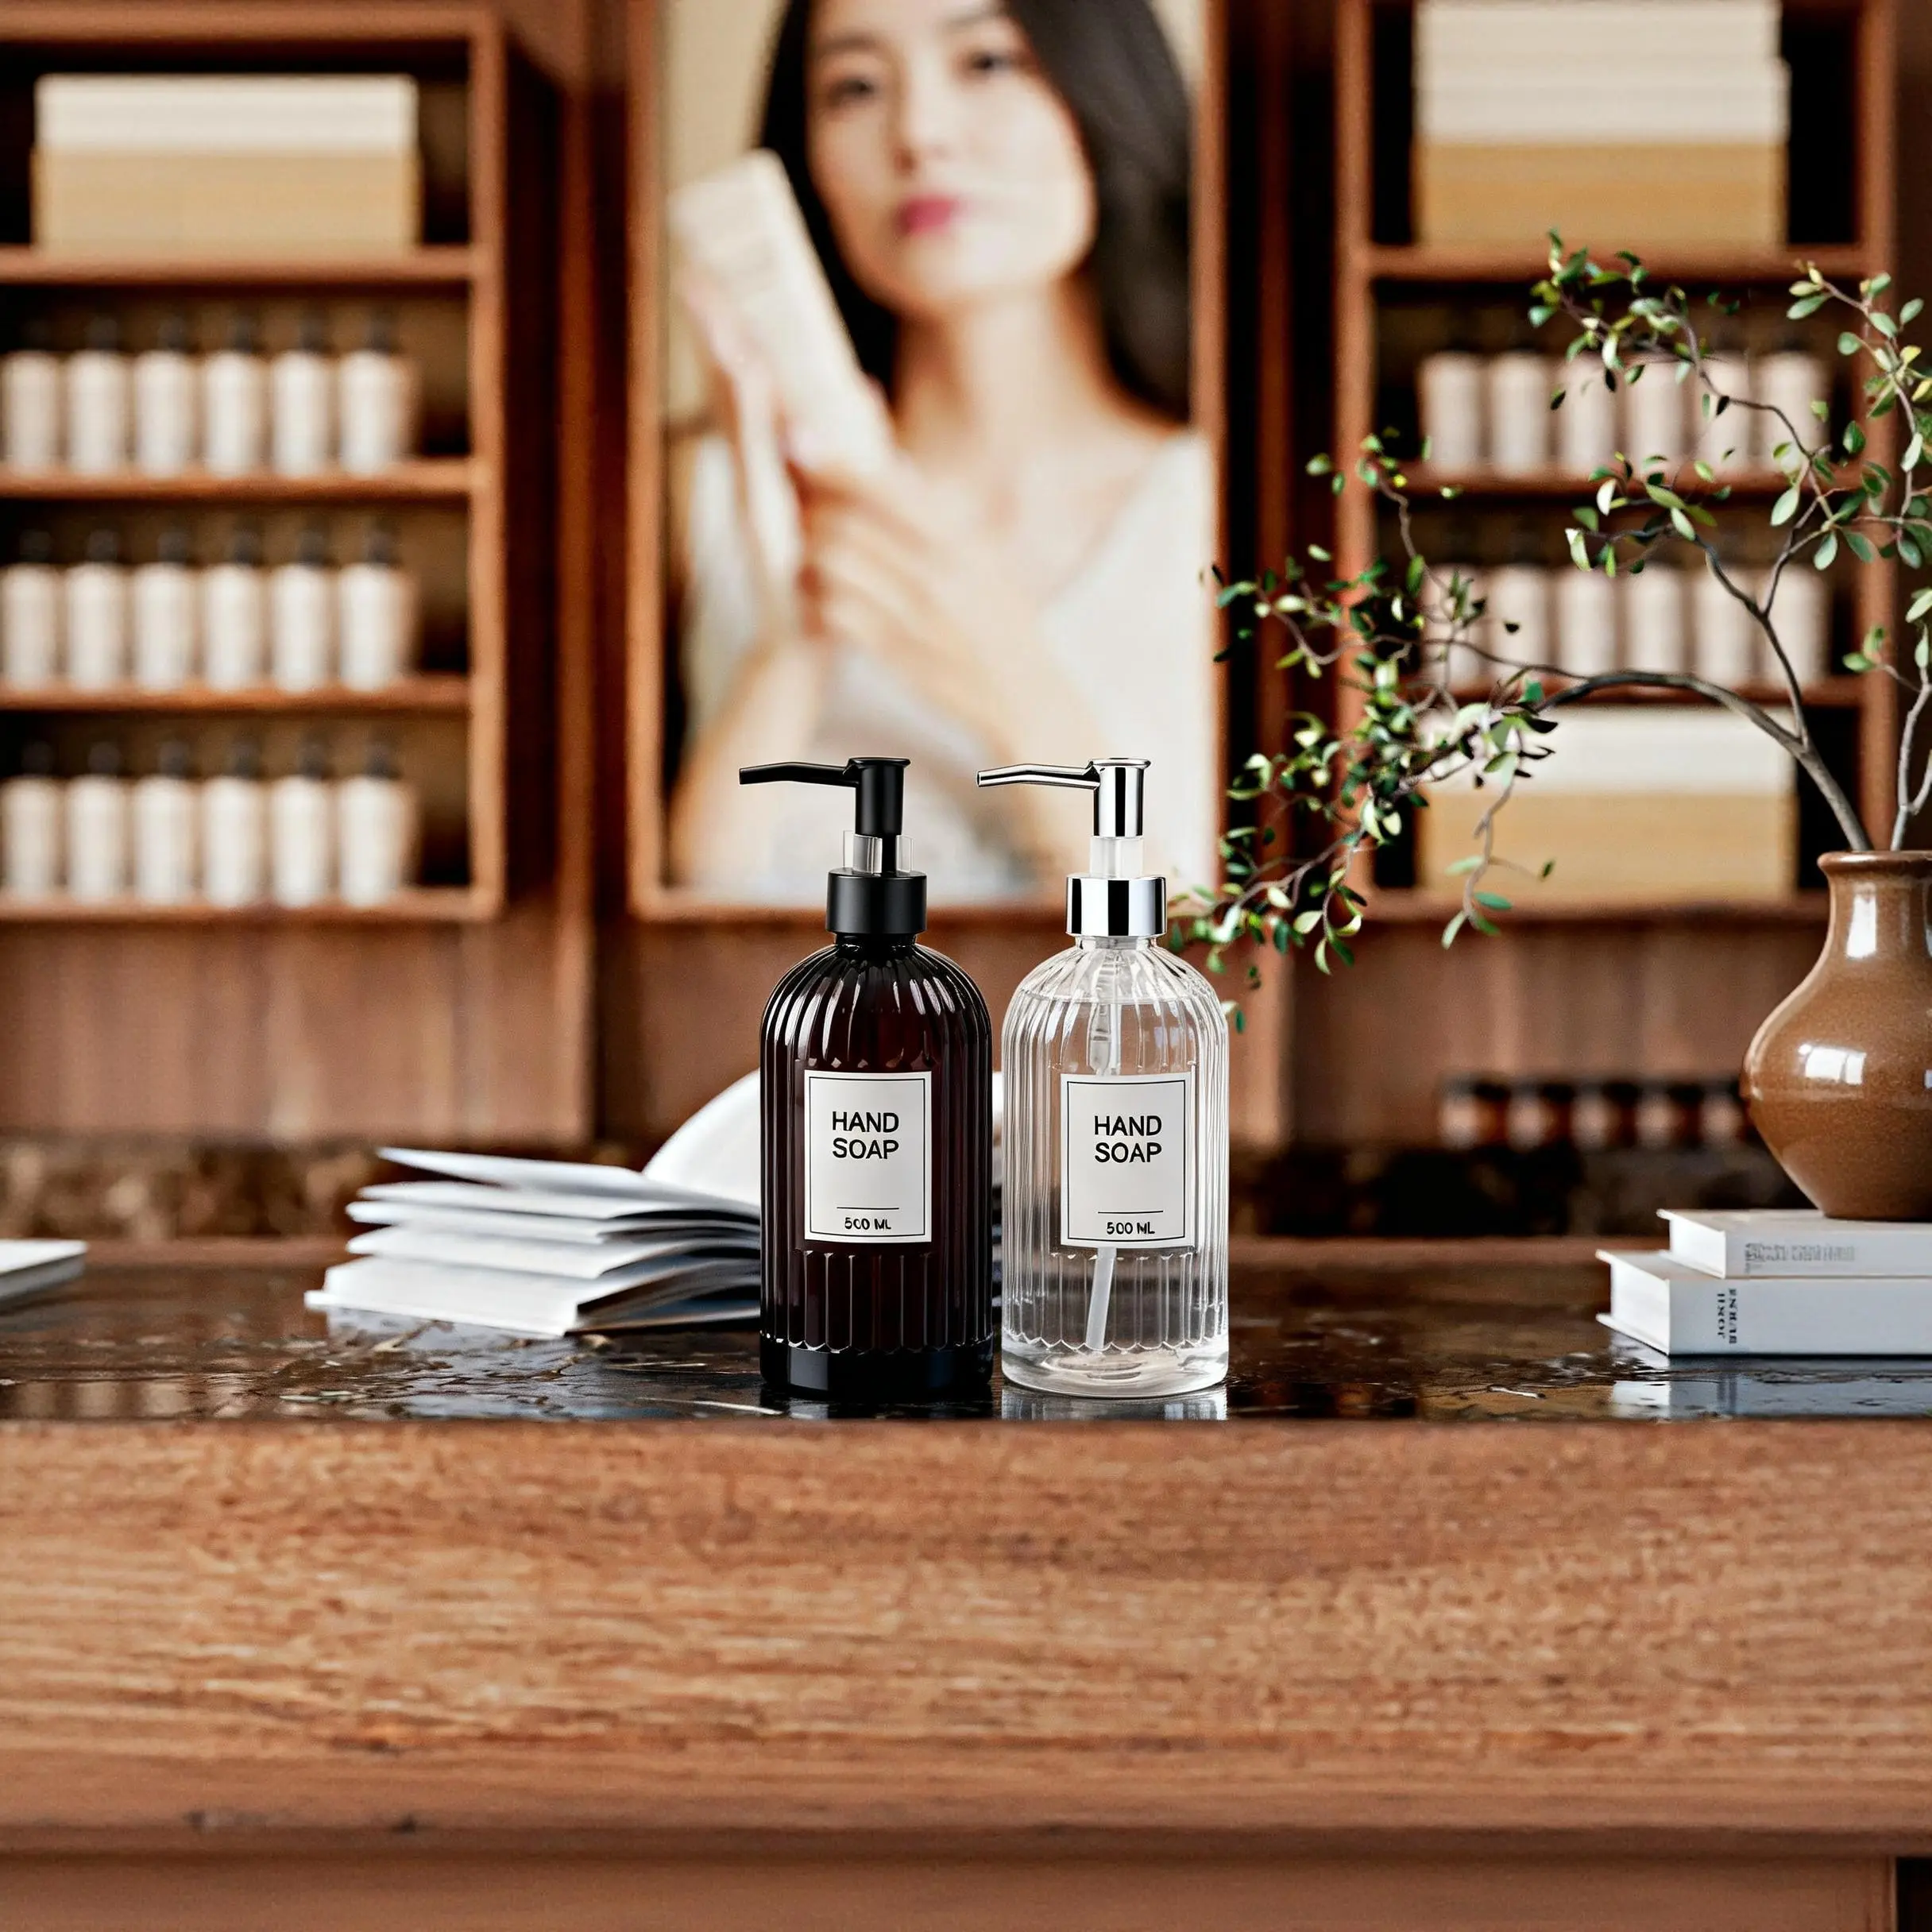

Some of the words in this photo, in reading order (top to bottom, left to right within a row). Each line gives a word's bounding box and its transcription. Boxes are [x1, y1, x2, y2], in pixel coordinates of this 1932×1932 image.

[832, 1111, 899, 1134] HAND
[1094, 1115, 1162, 1137] HAND
[832, 1138, 899, 1160] SOAP
[1094, 1142, 1162, 1164] SOAP
[844, 1216, 871, 1231] 500
[874, 1218, 892, 1231] ML
[1106, 1221, 1134, 1235] 500
[1136, 1221, 1156, 1235] ML
